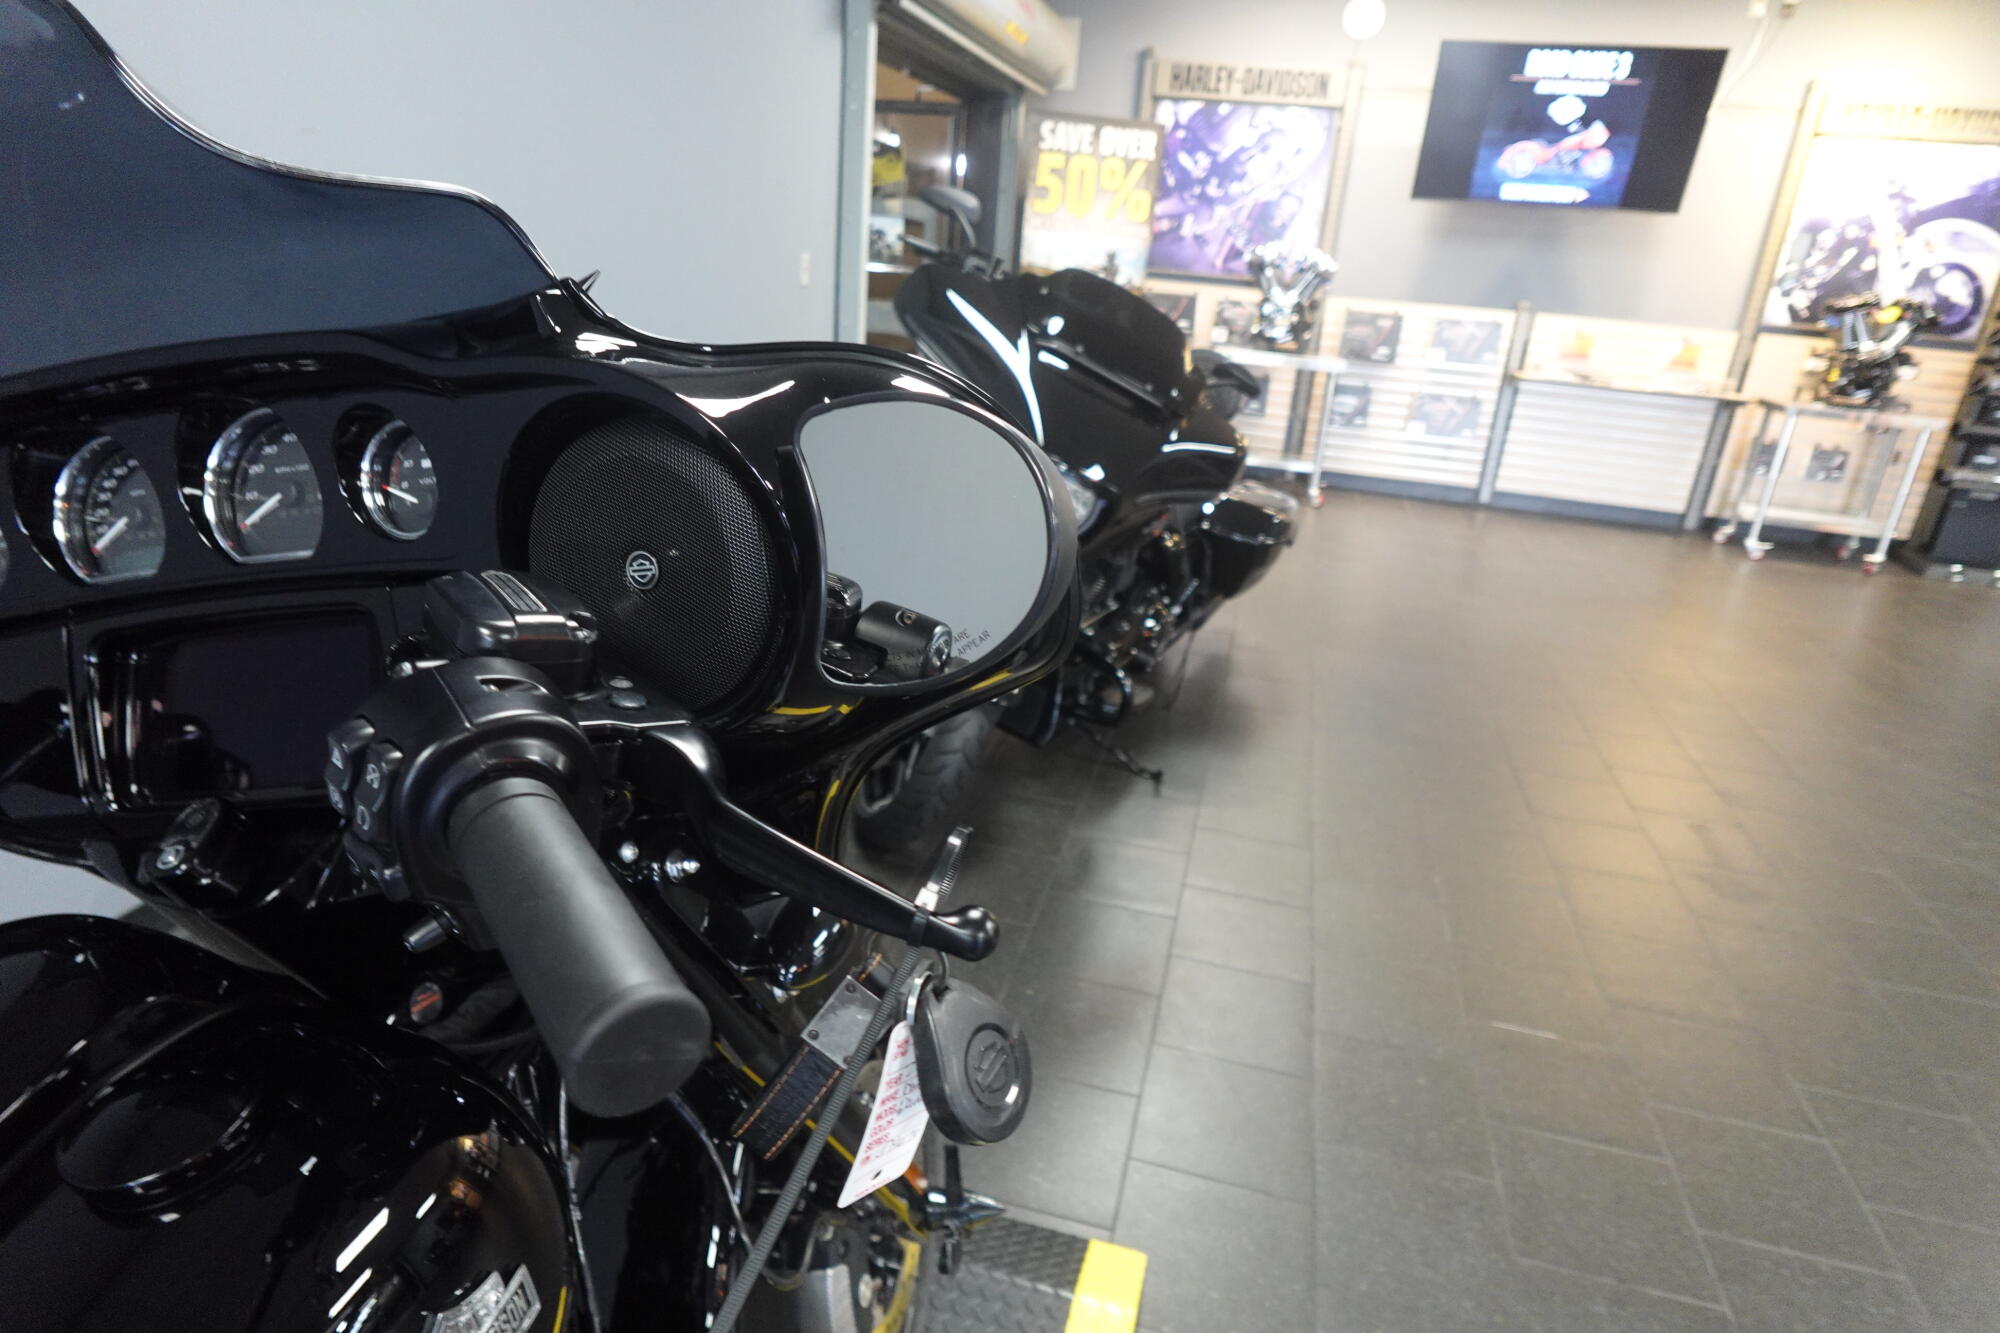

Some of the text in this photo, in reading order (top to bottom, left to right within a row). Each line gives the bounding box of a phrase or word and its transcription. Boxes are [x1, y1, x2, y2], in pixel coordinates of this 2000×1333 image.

[1169, 63, 1331, 98] HARLEY-DAVIDSON
[1039, 119, 1159, 161] SAVE OVER
[1031, 151, 1153, 224] 50%
[953, 629, 970, 642] ARE
[957, 630, 991, 656] APPEAR
